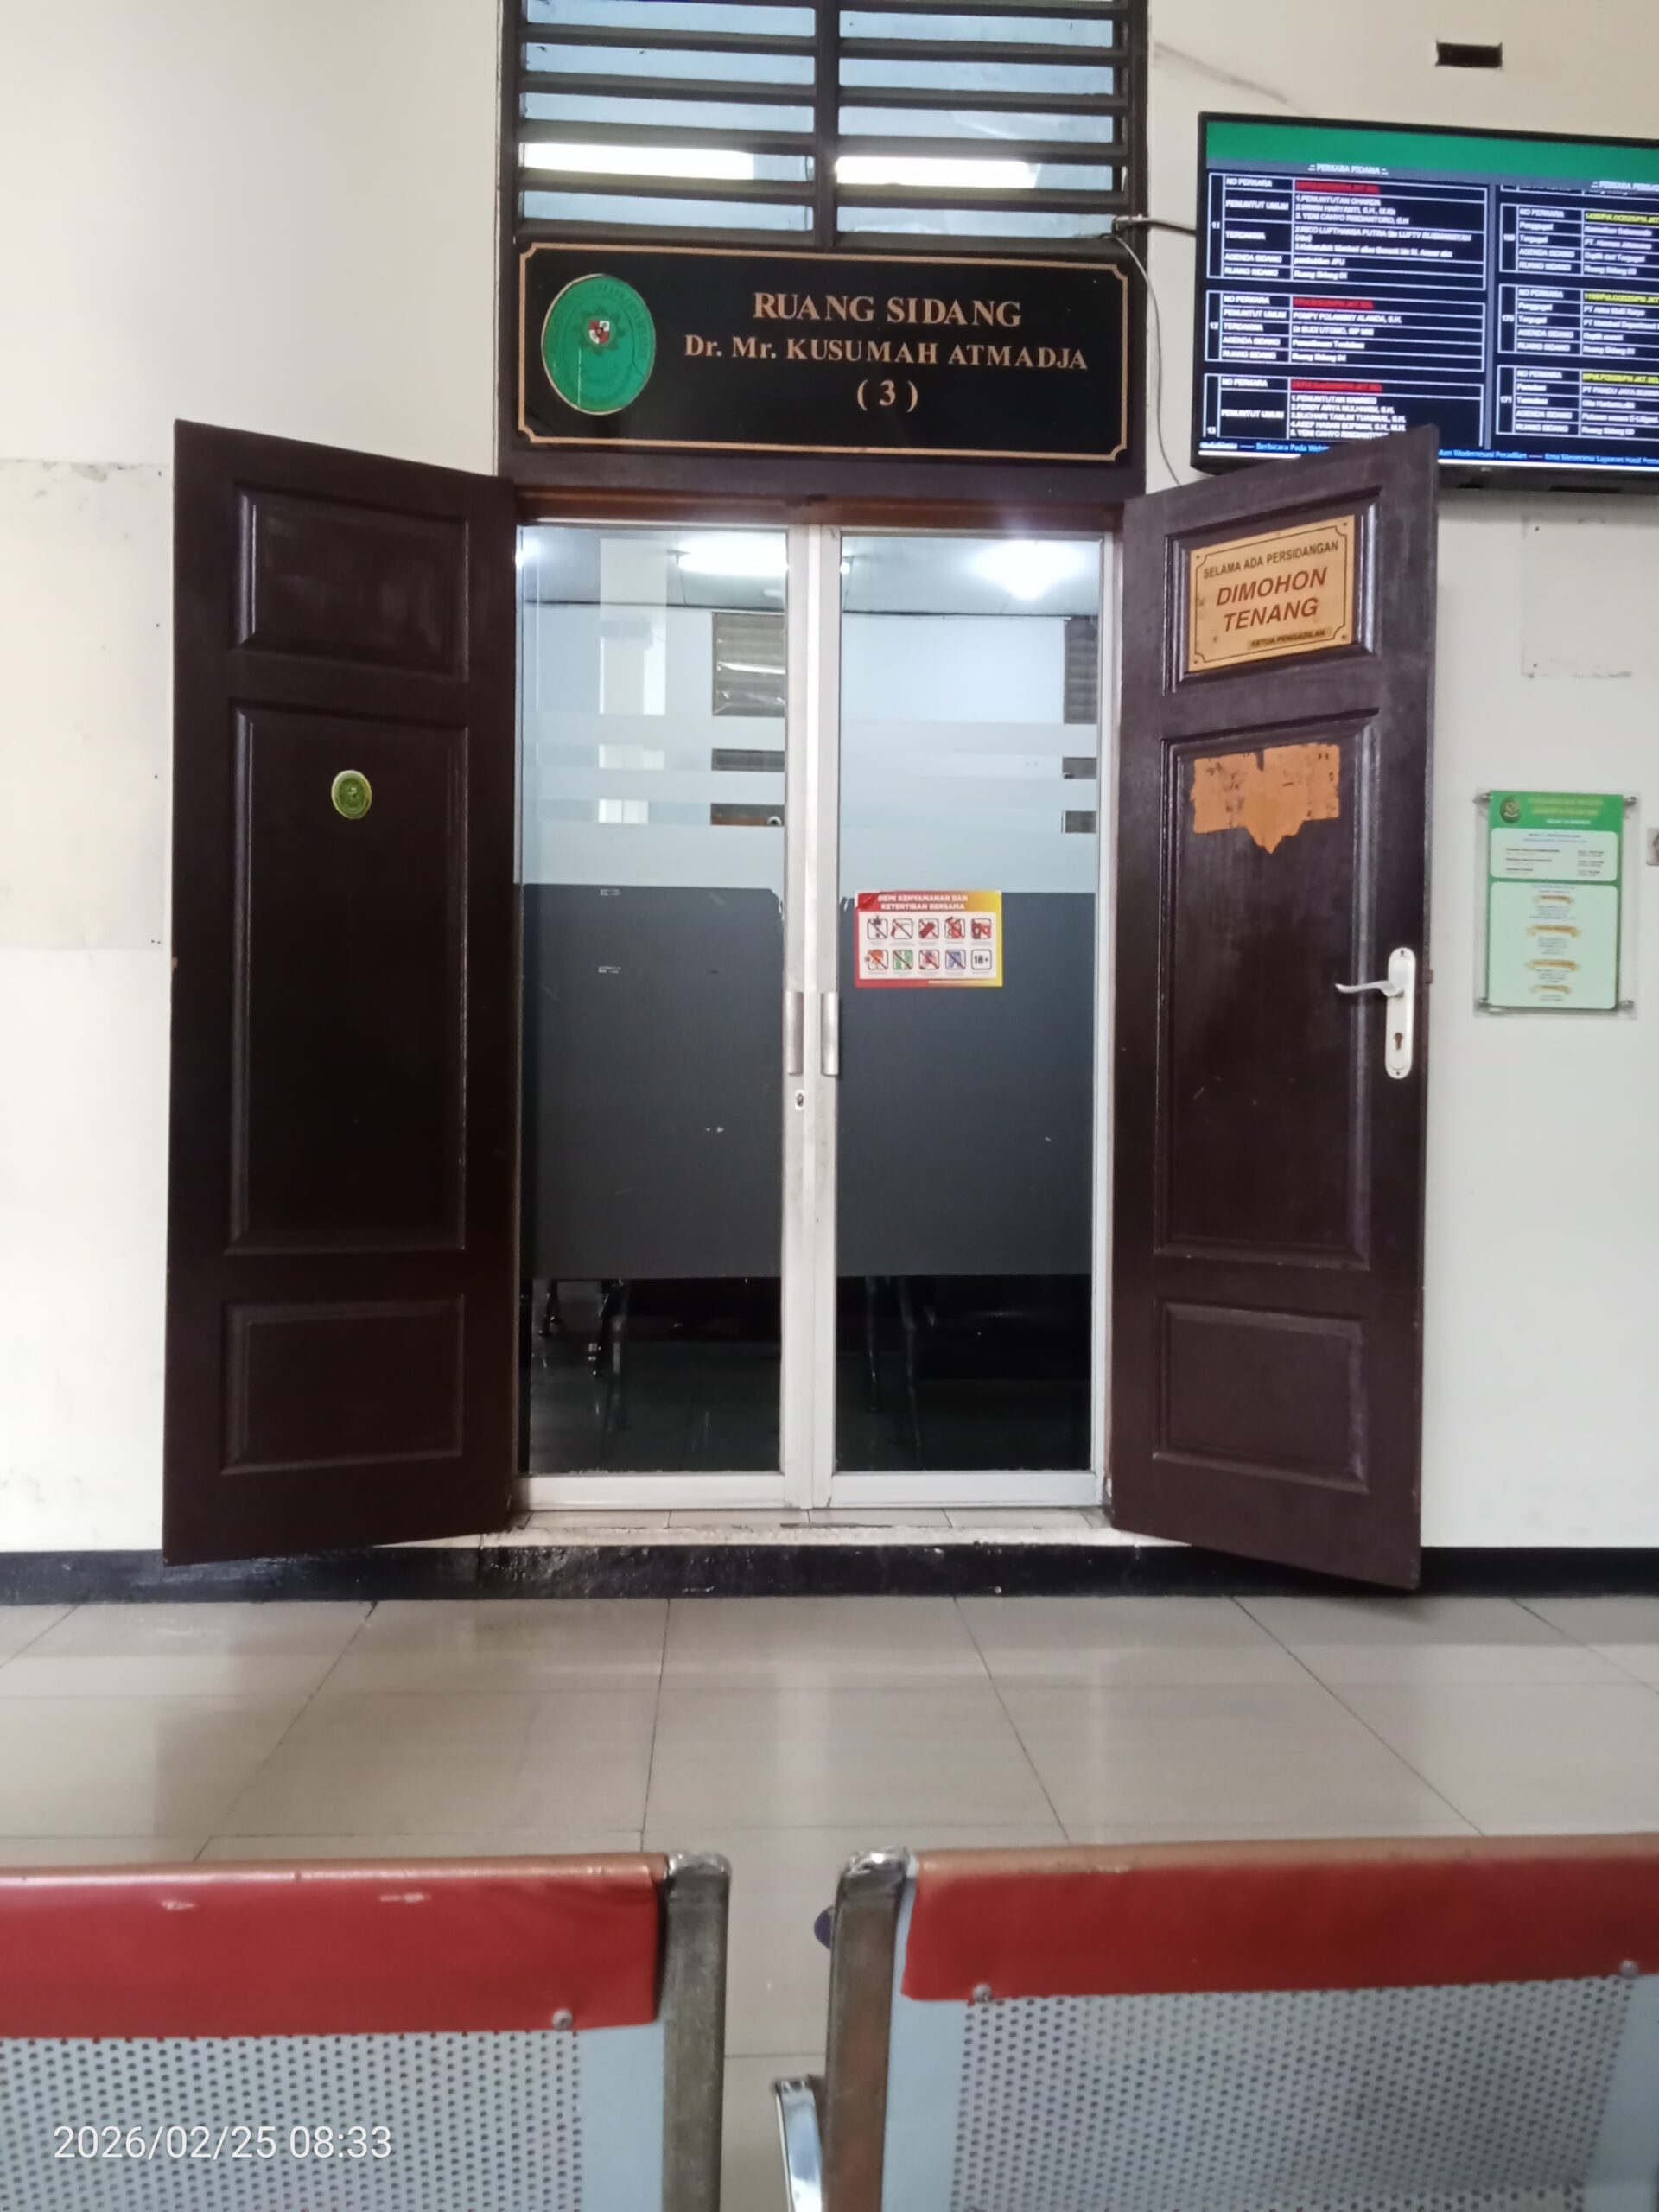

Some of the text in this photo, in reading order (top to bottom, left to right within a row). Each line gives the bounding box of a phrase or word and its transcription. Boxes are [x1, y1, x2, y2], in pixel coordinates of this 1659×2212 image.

[1238, 178, 1273, 188] PERKARA
[753, 292, 1022, 327] RUANG SIDANG
[1236, 296, 1270, 305] PERKARA
[684, 334, 1088, 370] Dr. Mr. KUSUMAH ATMADJA
[1234, 378, 1268, 388] PERKARA
[1204, 540, 1339, 579] SELAMA ADA PERSIDANGAN
[1216, 566, 1328, 607] DIMOHON
[1224, 597, 1319, 632] TENANG
